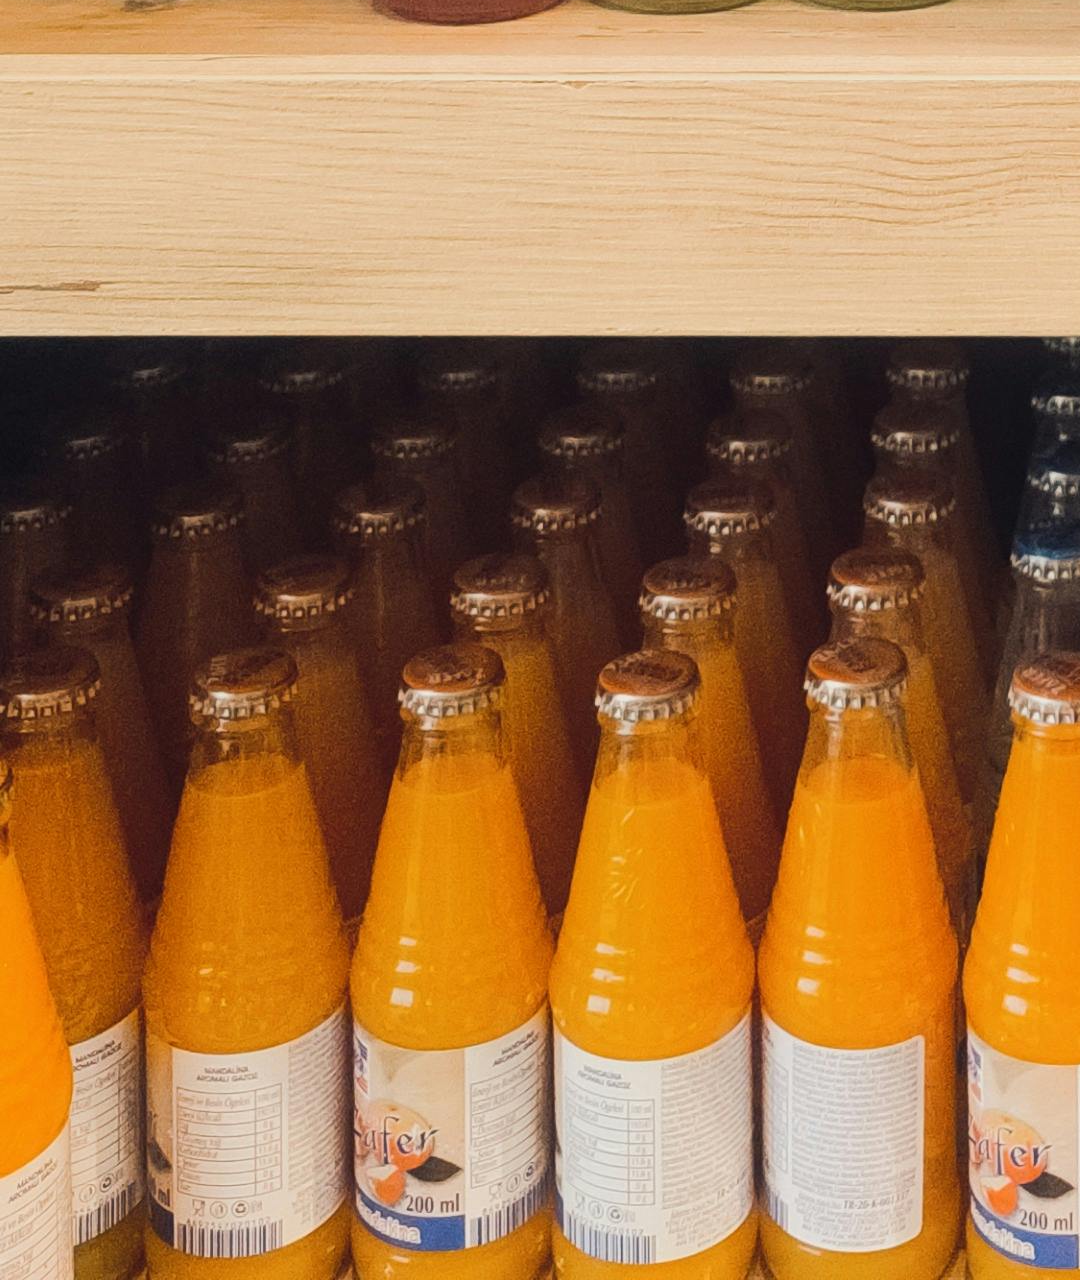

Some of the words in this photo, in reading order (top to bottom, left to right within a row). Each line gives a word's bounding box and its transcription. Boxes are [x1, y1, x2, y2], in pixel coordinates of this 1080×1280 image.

[405, 1194, 434, 1214] 200
[439, 1193, 460, 1213] ml
[1019, 1208, 1048, 1229] 200
[1053, 1211, 1074, 1231] ml
